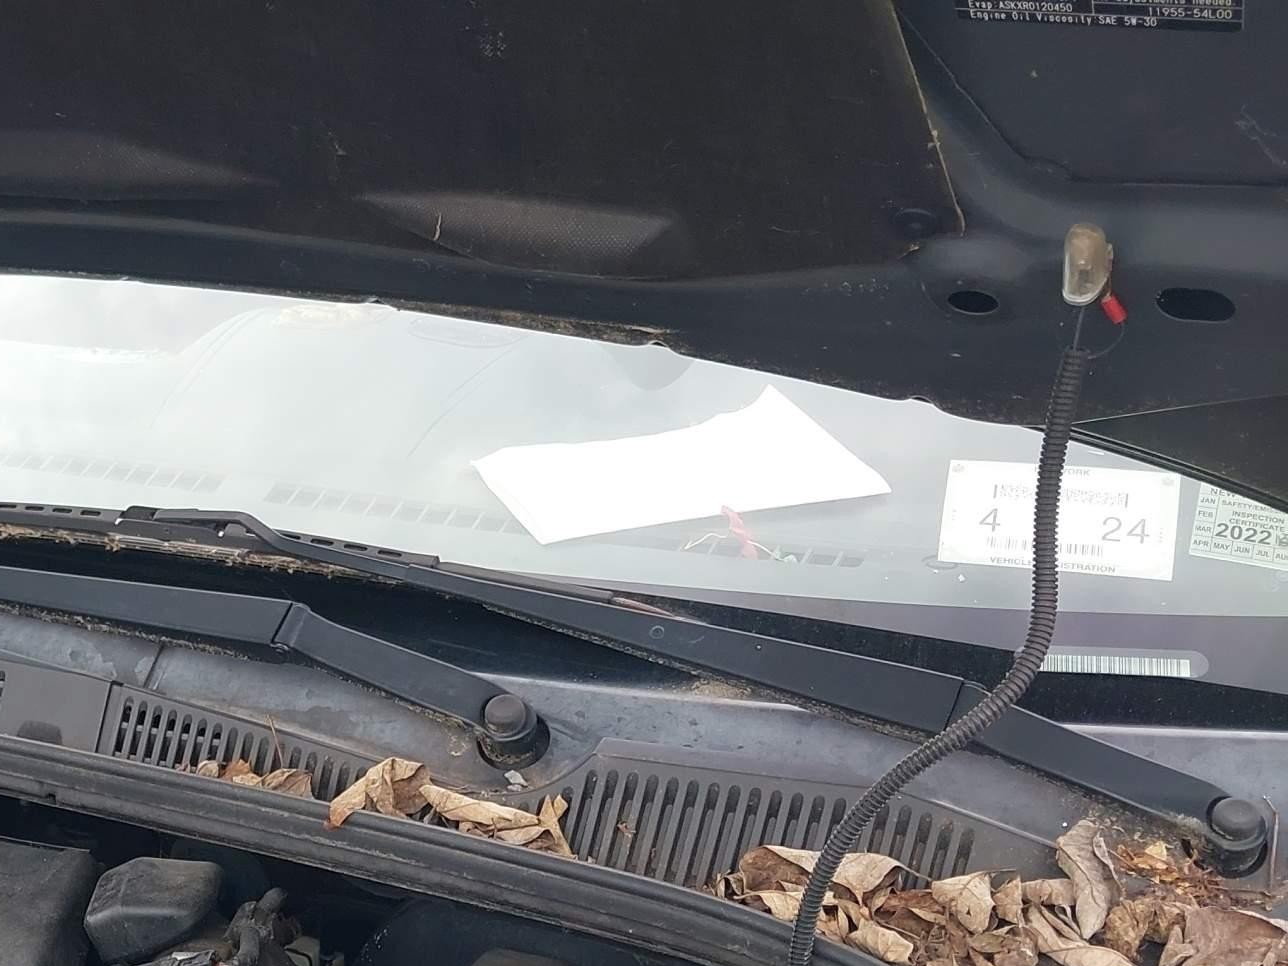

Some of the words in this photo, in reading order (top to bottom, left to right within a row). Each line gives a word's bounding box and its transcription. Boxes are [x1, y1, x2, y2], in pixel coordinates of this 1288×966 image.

[970, 10, 1006, 20] Engine
[1011, 11, 1030, 20] Oil
[1199, 497, 1216, 505] JAN
[978, 507, 1001, 533] 4
[1232, 510, 1285, 524] INSPECTION
[1101, 516, 1150, 545] 24
[1214, 522, 1272, 546] 2022
[1213, 542, 1231, 551] MAY
